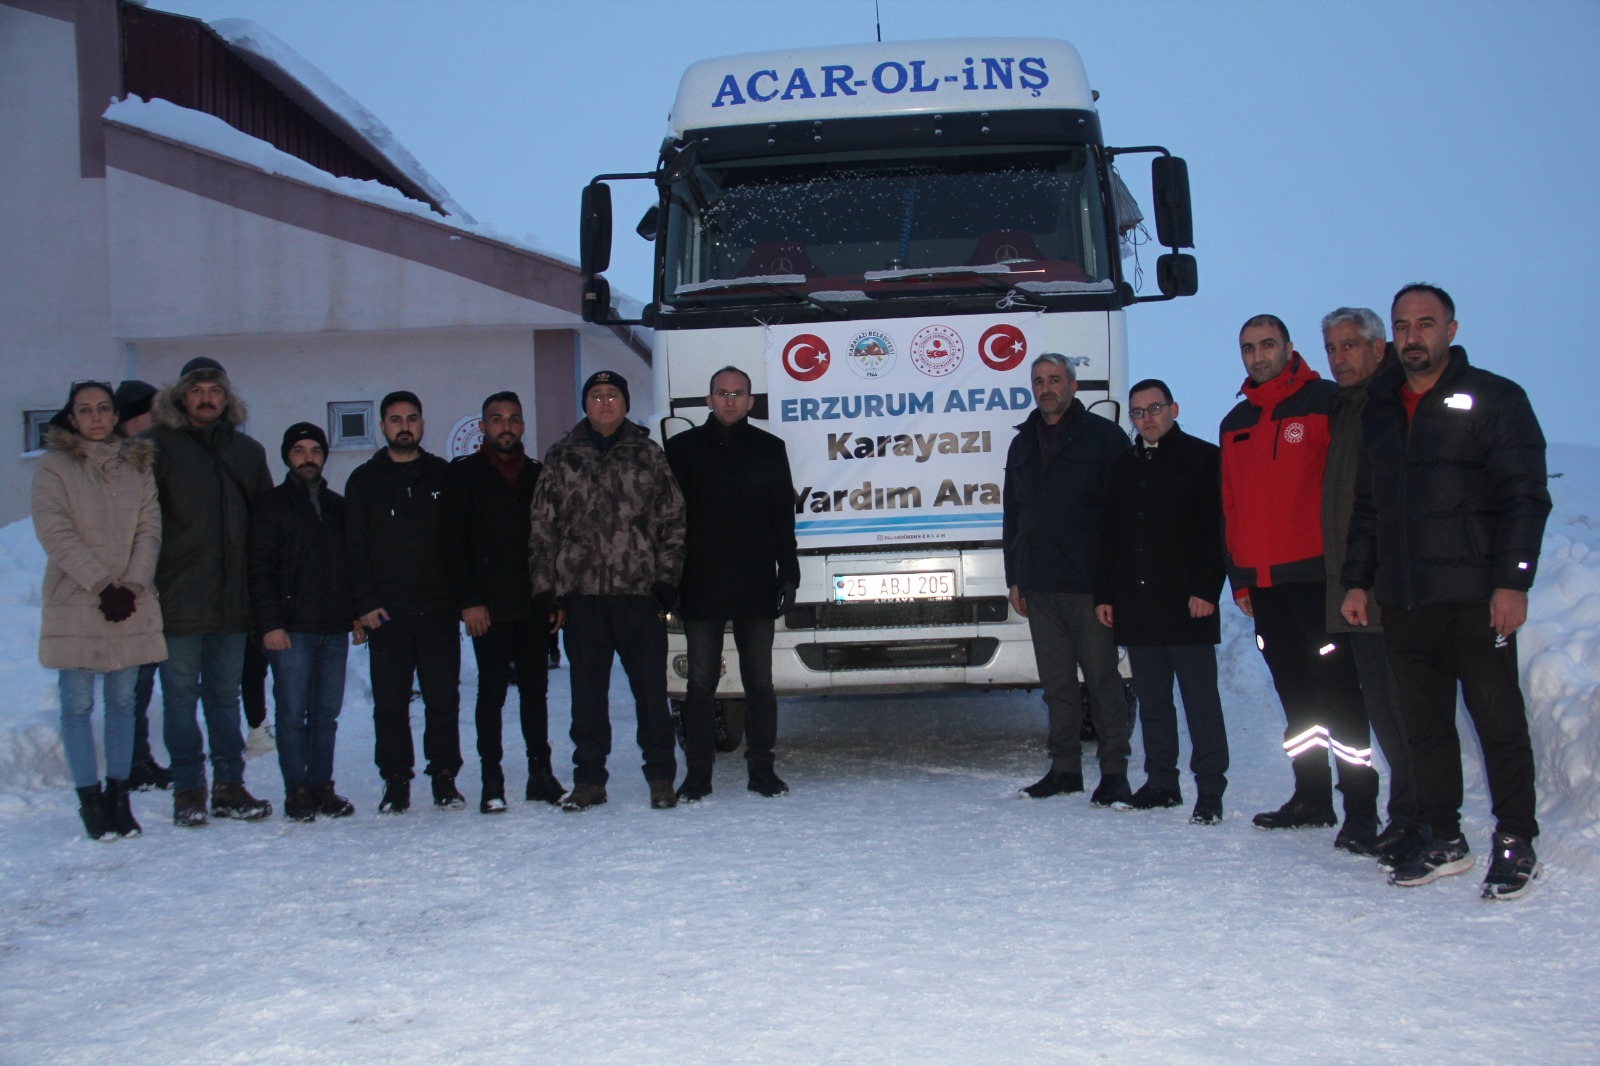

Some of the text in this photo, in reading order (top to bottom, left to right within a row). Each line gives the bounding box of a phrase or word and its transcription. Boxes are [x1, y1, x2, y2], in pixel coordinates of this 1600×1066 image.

[781, 386, 1032, 422] ERZURUM AFAD
[827, 430, 992, 463] Karayazı
[794, 480, 922, 514] Yardım
[847, 575, 949, 597] 25 ABJ 205
